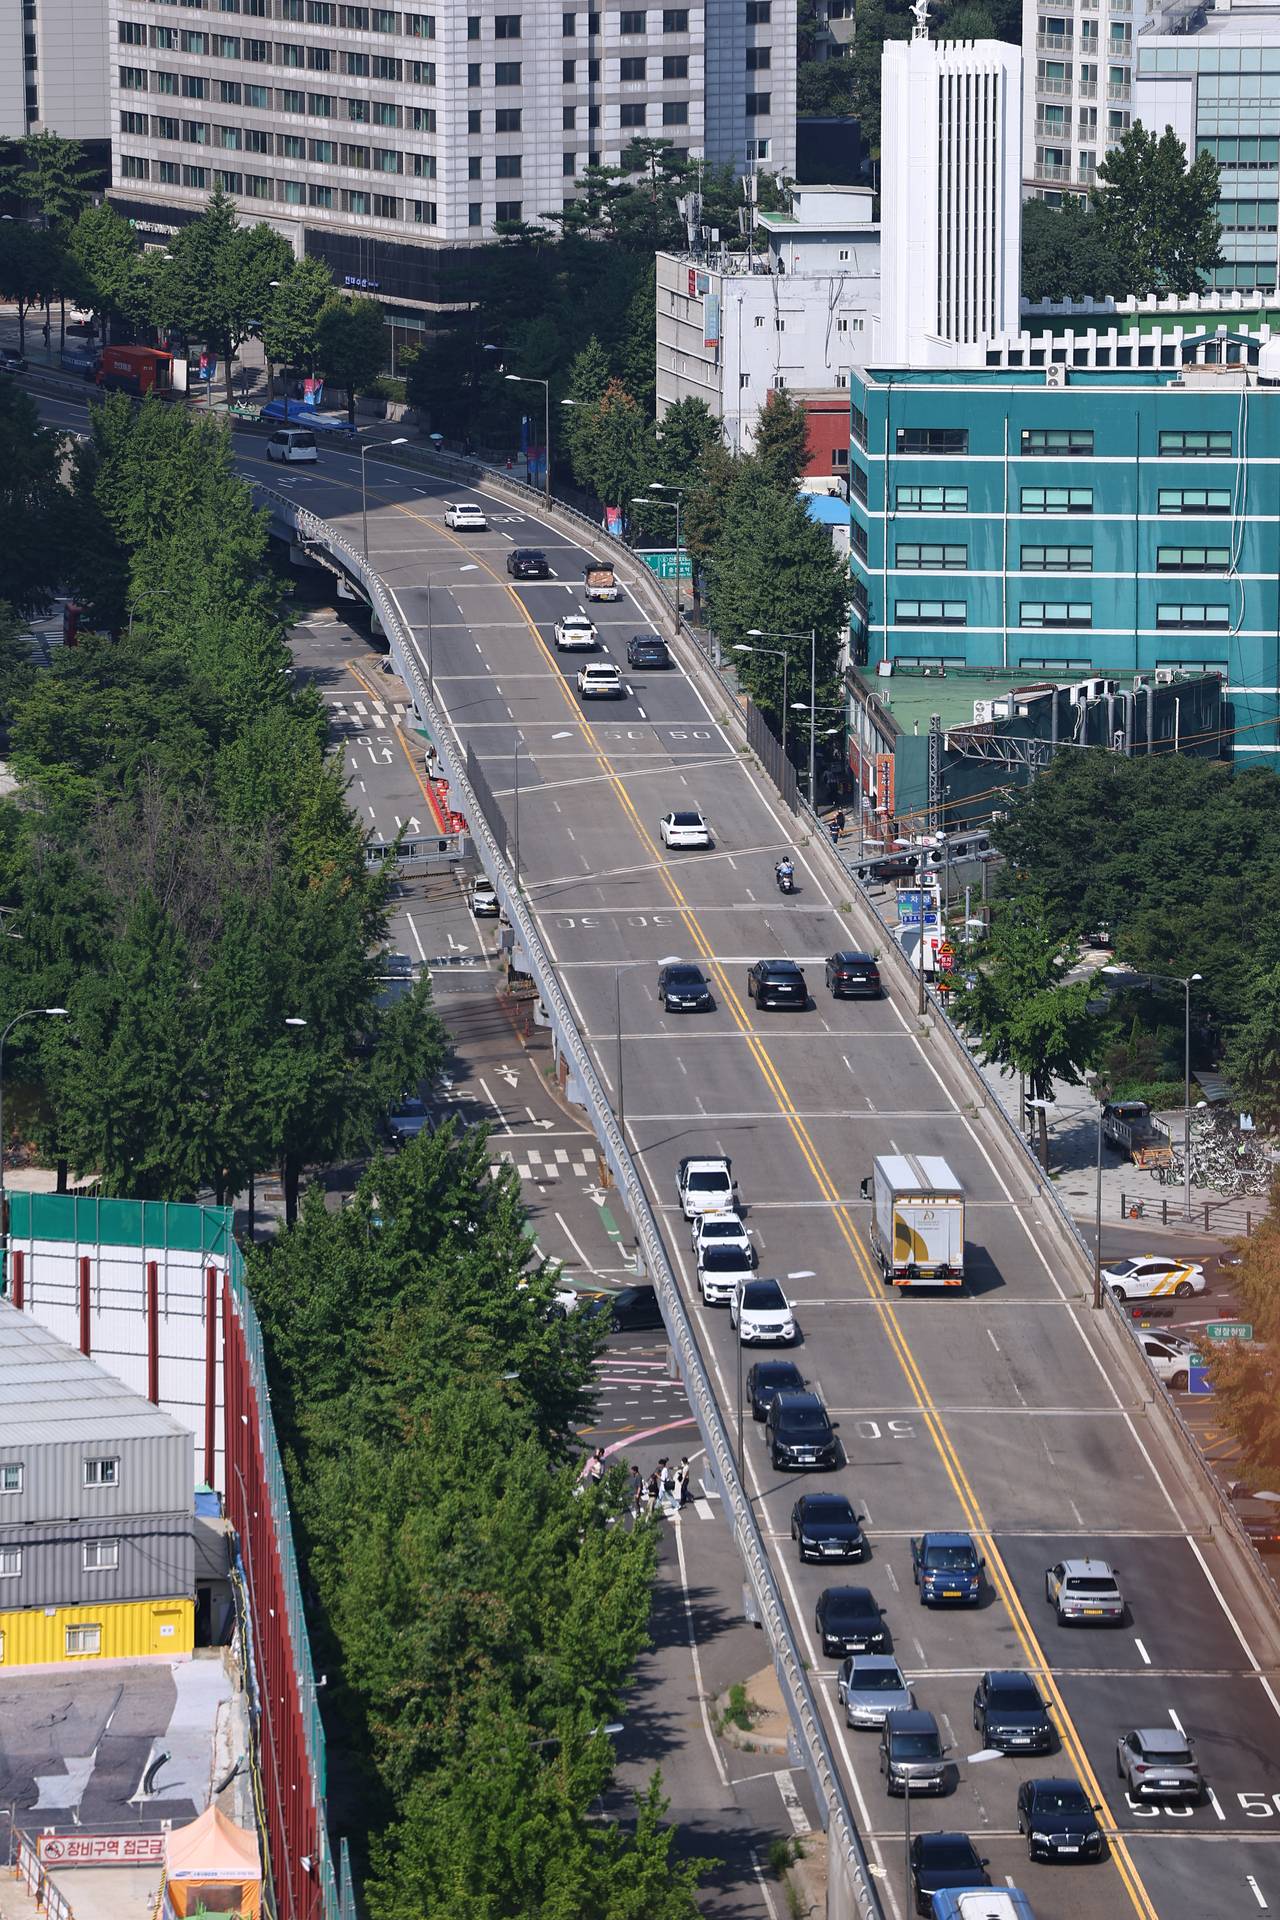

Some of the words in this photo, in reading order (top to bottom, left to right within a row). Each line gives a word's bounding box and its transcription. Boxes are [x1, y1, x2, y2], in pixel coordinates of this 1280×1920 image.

[357, 736, 393, 745] 50
[604, 730, 645, 740] 50
[669, 731, 711, 740] 50
[556, 917, 600, 929] 50
[627, 916, 674, 927] 50
[1213, 1327, 1247, 1337] 경찰청앞
[854, 1420, 917, 1439] 50
[1237, 1792, 1280, 1818] 5
[68, 1840, 119, 1857] 장비구역
[123, 1838, 165, 1856] 접근금
